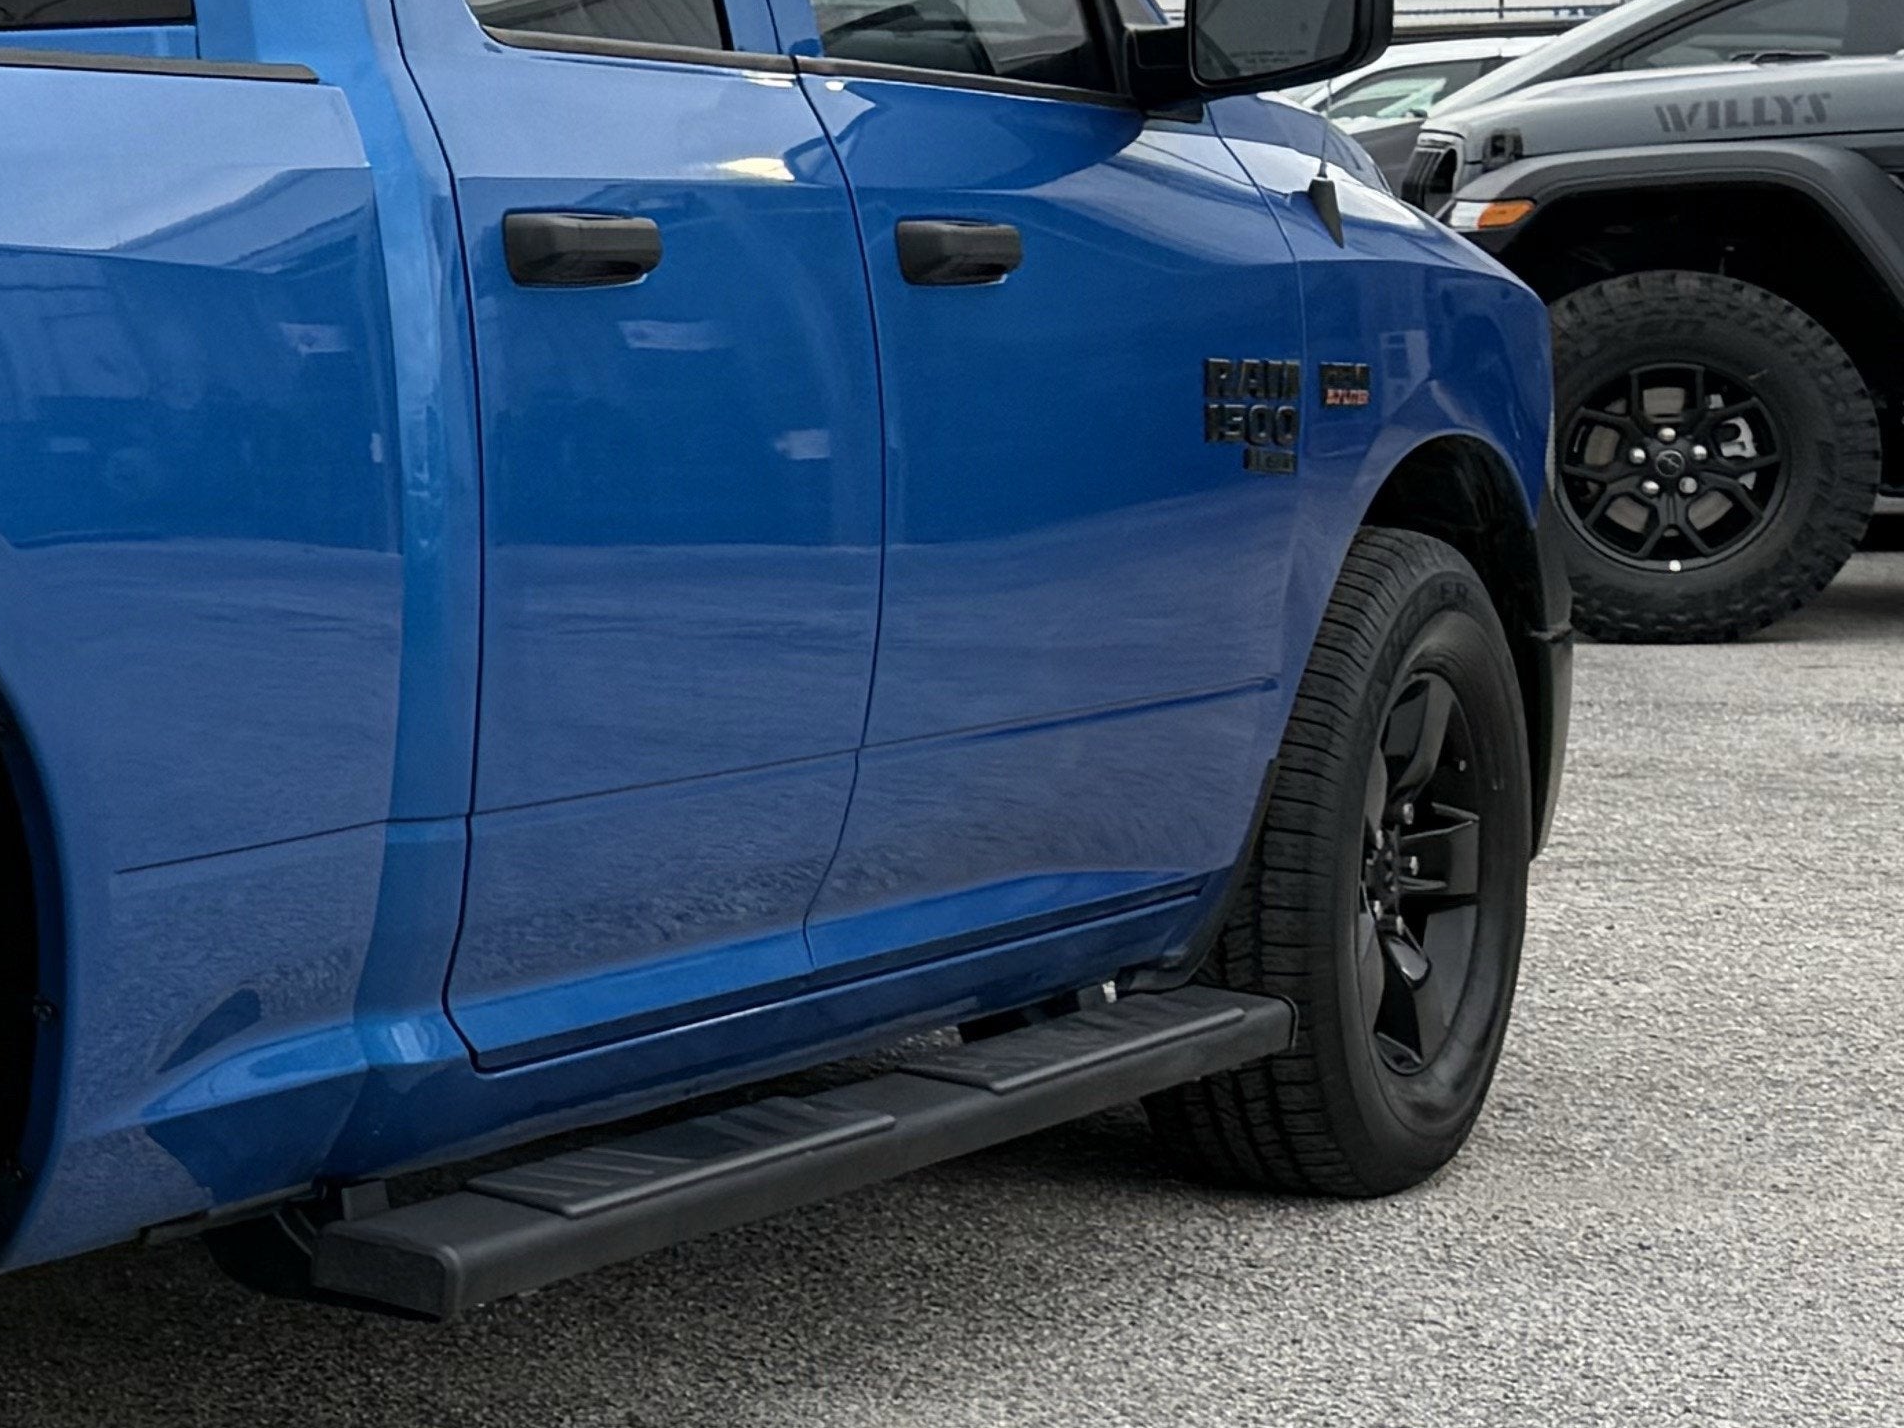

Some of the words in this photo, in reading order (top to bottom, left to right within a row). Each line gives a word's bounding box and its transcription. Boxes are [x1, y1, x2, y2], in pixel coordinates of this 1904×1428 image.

[1653, 92, 1832, 133] WILLYS
[1206, 358, 1300, 398] RAM
[1206, 404, 1298, 446] 1500
